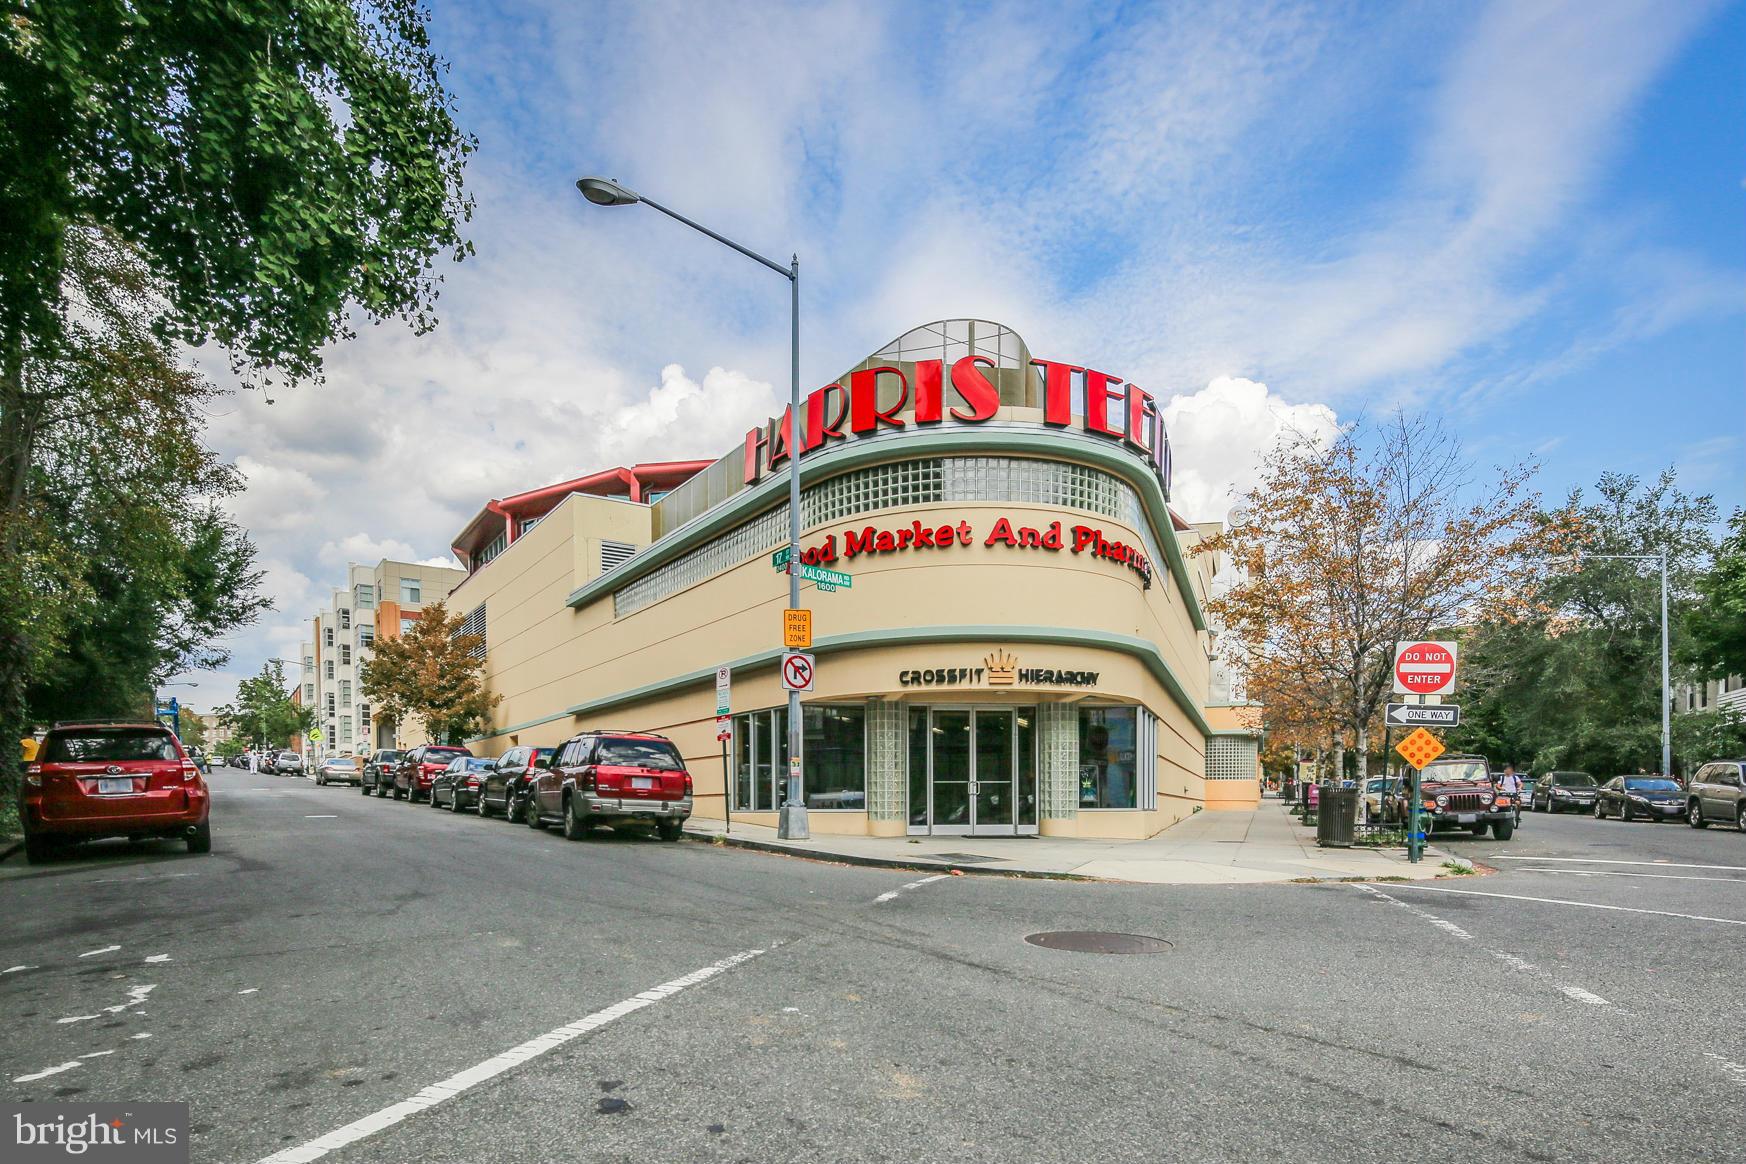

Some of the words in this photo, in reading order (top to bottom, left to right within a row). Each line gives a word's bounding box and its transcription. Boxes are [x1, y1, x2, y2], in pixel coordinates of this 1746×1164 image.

[744, 355, 1001, 484] HARRIS
[1029, 358, 1172, 502] TEE
[843, 520, 974, 558] Market
[984, 517, 1064, 551] And
[775, 552, 783, 565] 17
[802, 566, 844, 585] KALORAMA
[817, 582, 836, 592] 1600
[788, 613, 807, 622] DRUG
[788, 624, 806, 632] FREE
[789, 634, 806, 642] ZONE
[1405, 652, 1420, 661] DO
[1425, 652, 1447, 661] NOT
[898, 667, 985, 686] CROSSFIT
[1018, 668, 1100, 687] HIERARCHY
[1407, 674, 1441, 684] ENTER
[1407, 710, 1427, 719] ONE
[1430, 711, 1451, 720] WAY
